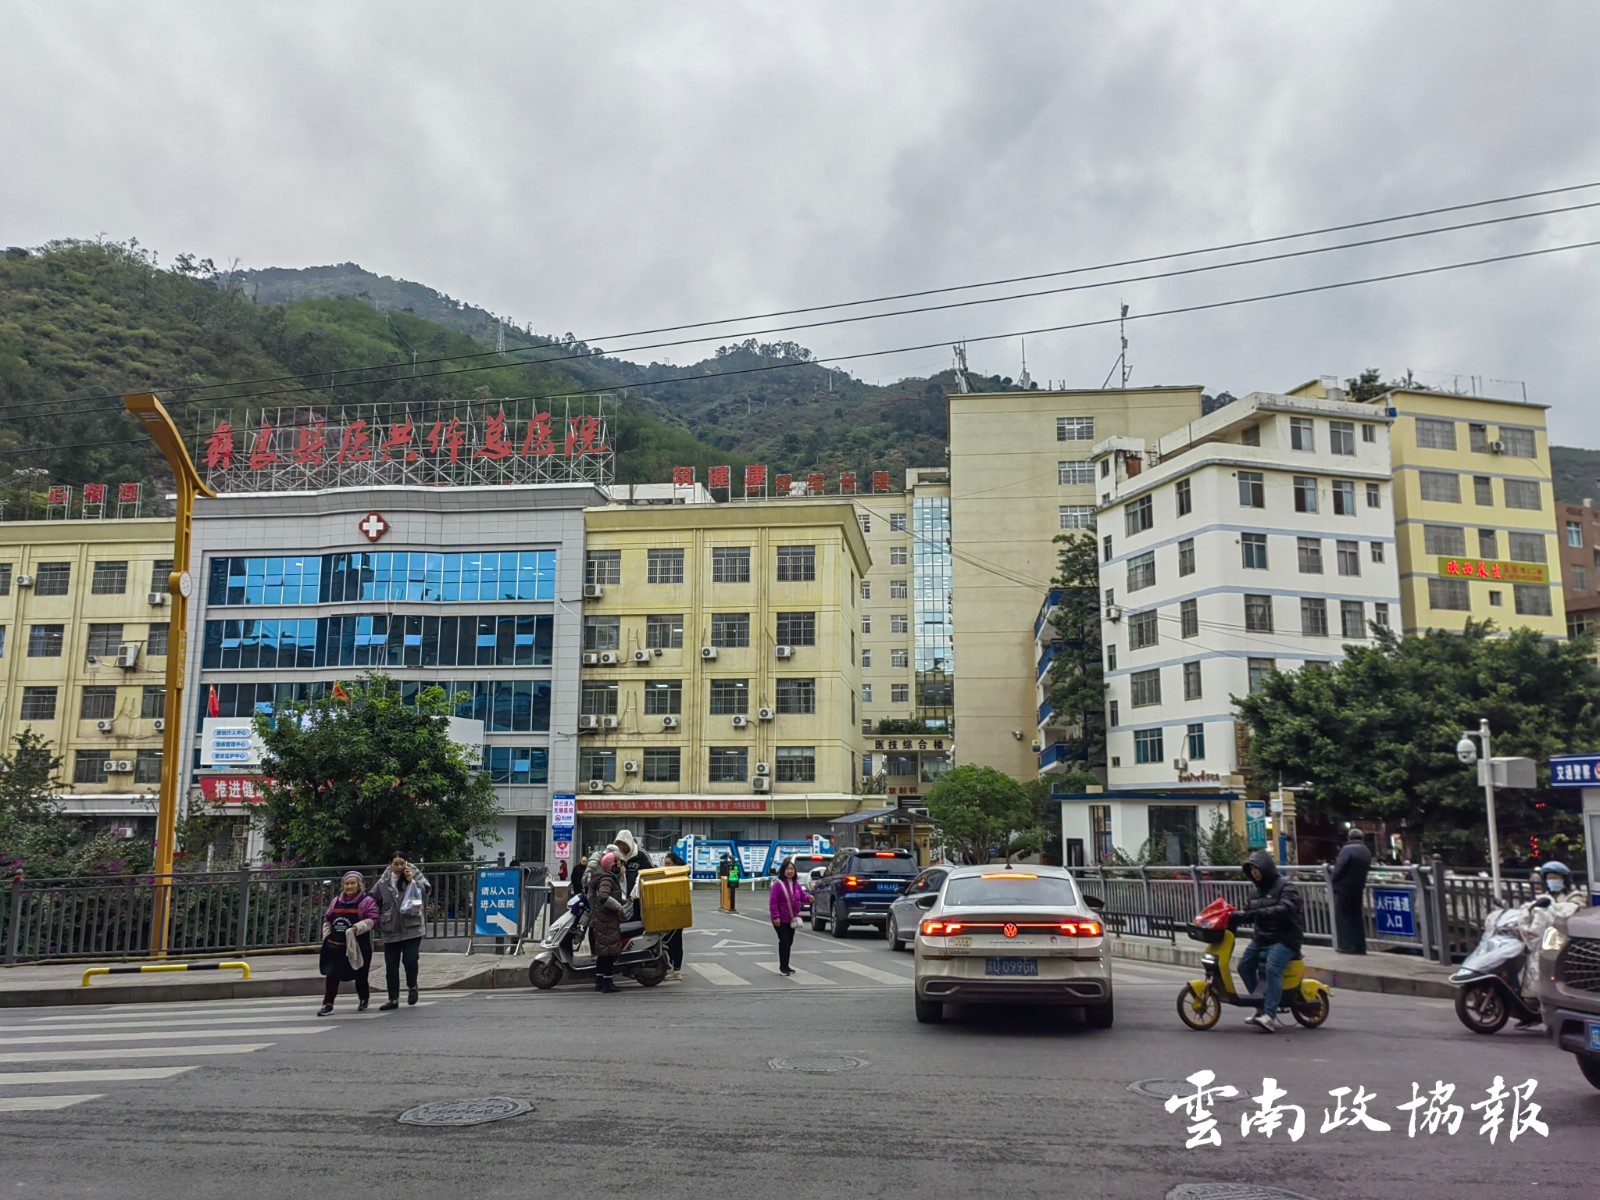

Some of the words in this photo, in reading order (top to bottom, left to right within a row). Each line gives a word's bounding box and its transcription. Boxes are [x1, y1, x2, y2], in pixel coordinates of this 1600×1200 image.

[875, 738, 943, 749] 医技综合楼
[1556, 764, 1591, 780] 交通警察
[481, 886, 515, 896] 请从入口
[480, 899, 515, 909] 进入医院
[1377, 896, 1411, 912] 人行通道
[1386, 914, 1403, 928] 入口
